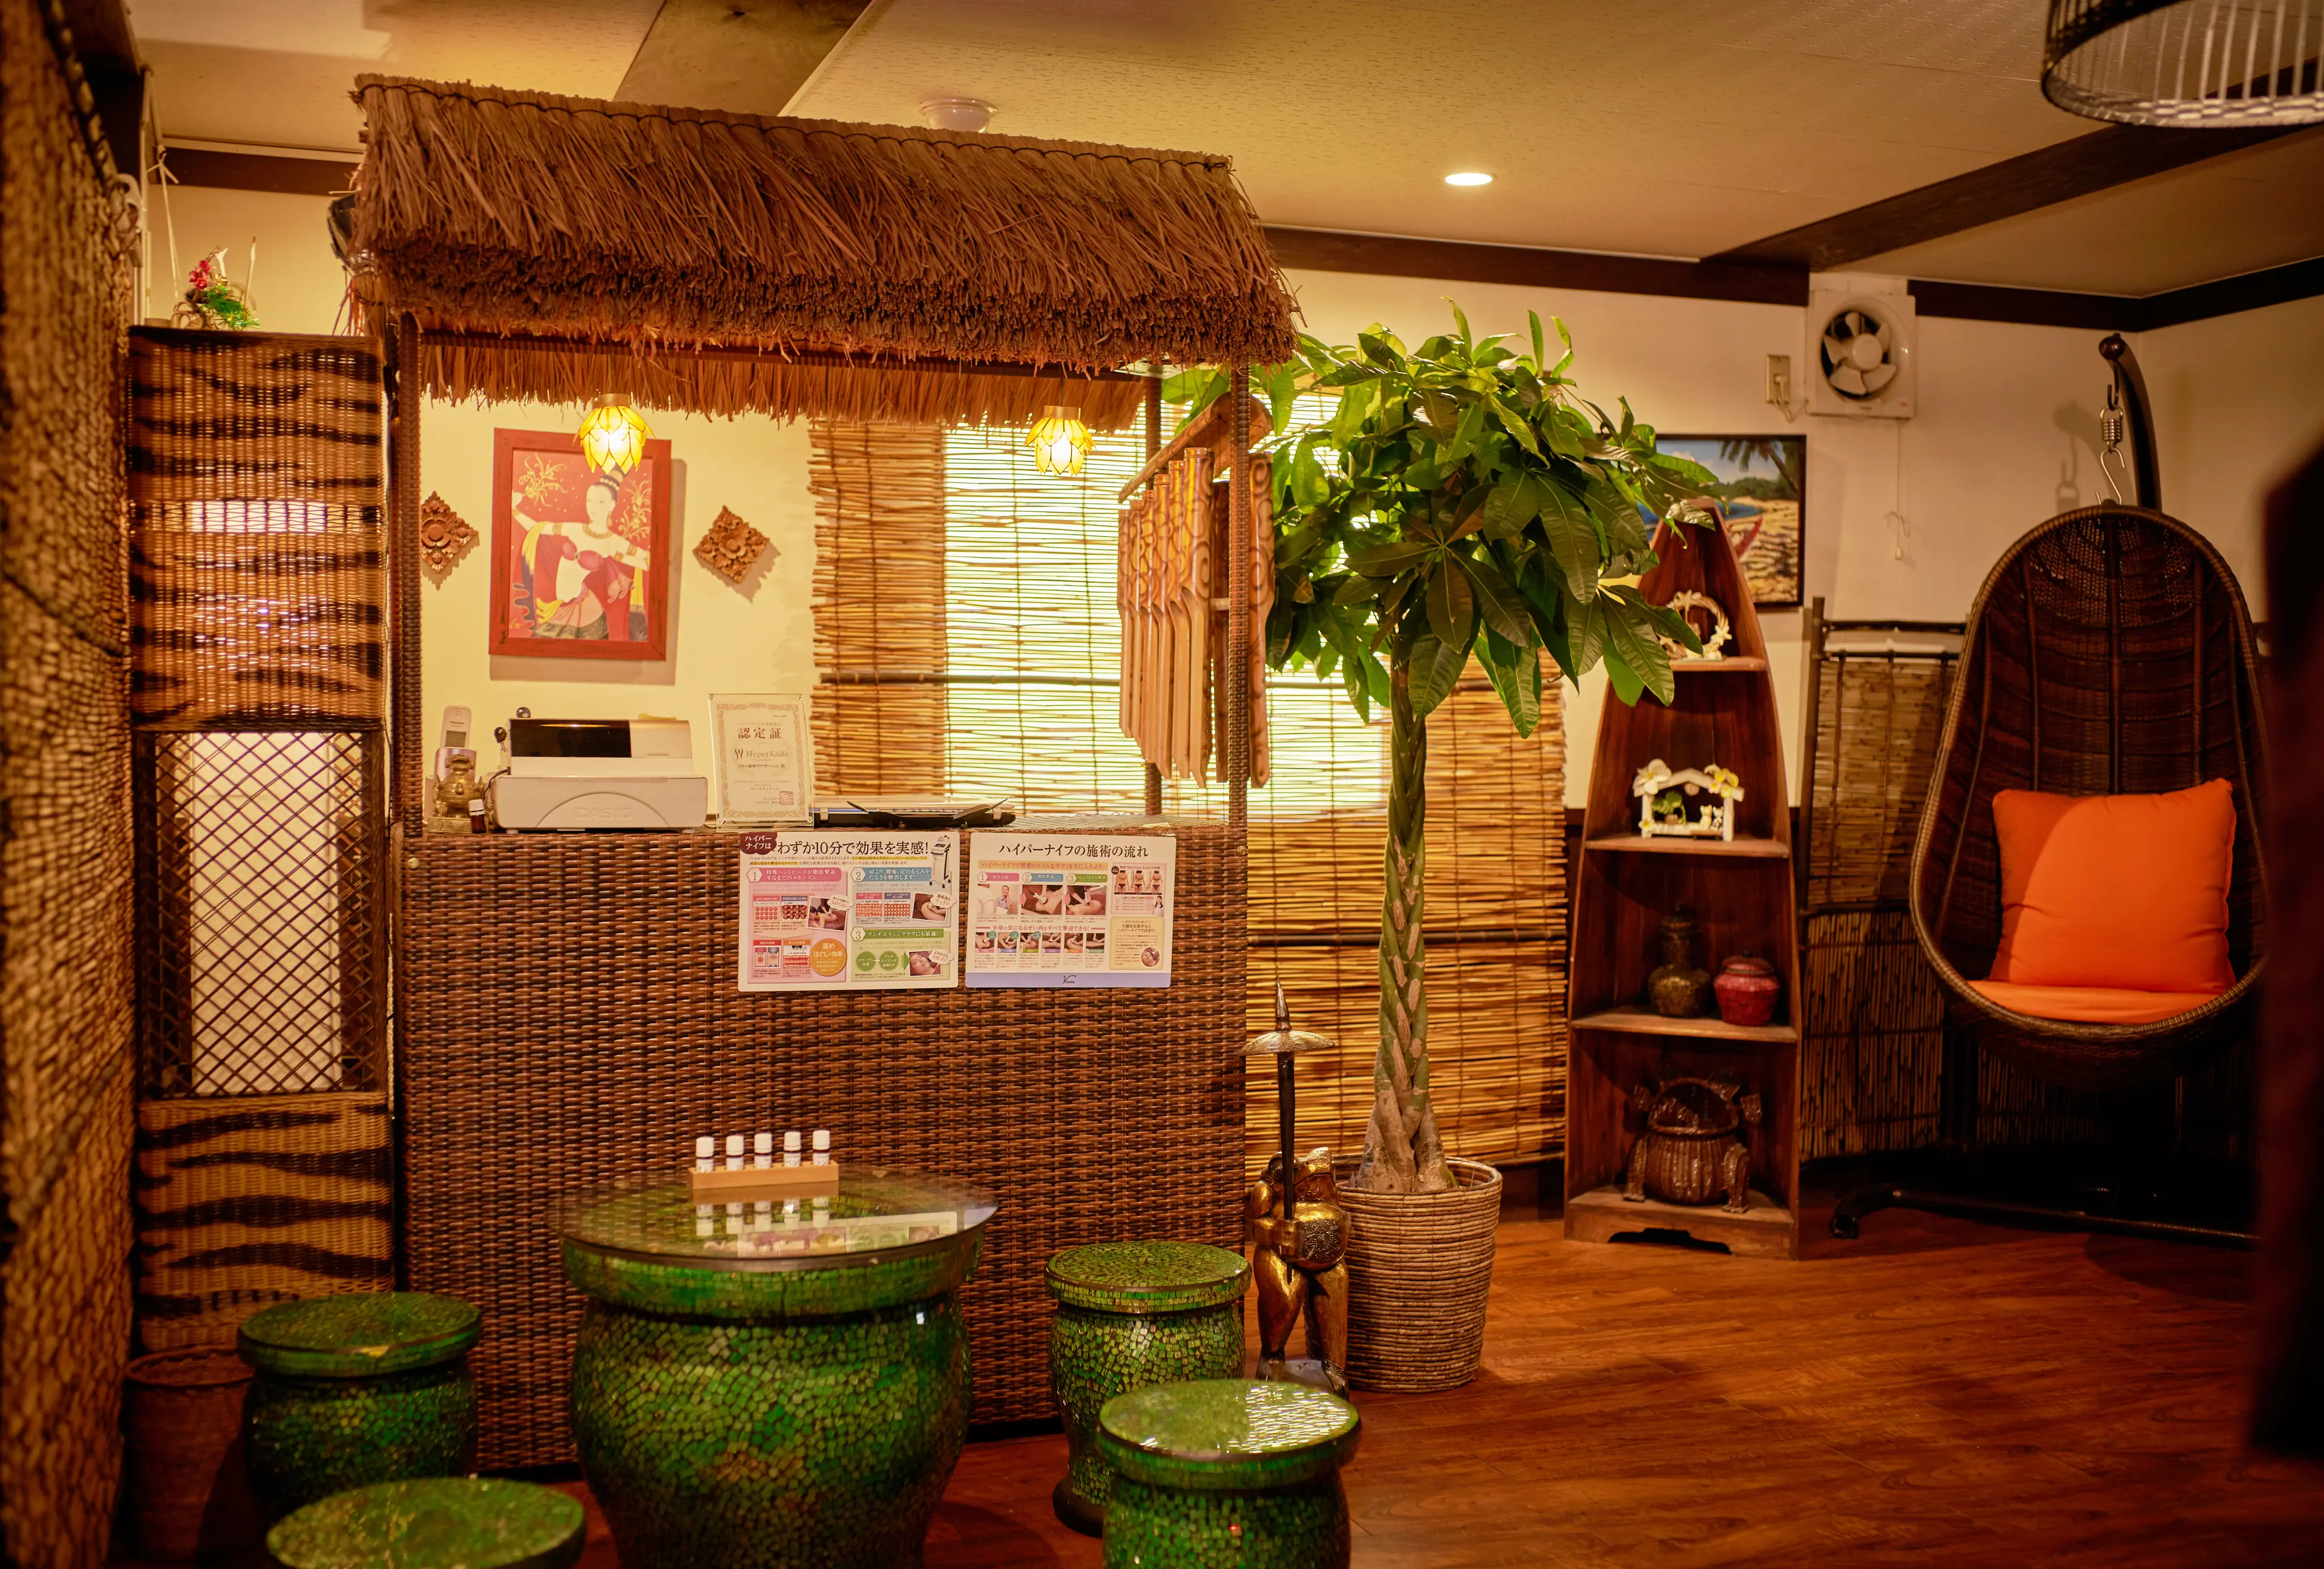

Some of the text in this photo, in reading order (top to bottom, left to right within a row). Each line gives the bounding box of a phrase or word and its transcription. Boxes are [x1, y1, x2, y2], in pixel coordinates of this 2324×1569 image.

[738, 727, 782, 739] 認定証
[574, 807, 634, 820] CASIO
[778, 840, 928, 855] わずか10分で効果を実感!
[999, 843, 1149, 858] ハイパーナイフの施術の流れ
[753, 872, 757, 880] 1
[856, 871, 861, 880] 2
[855, 931, 861, 940] 3
